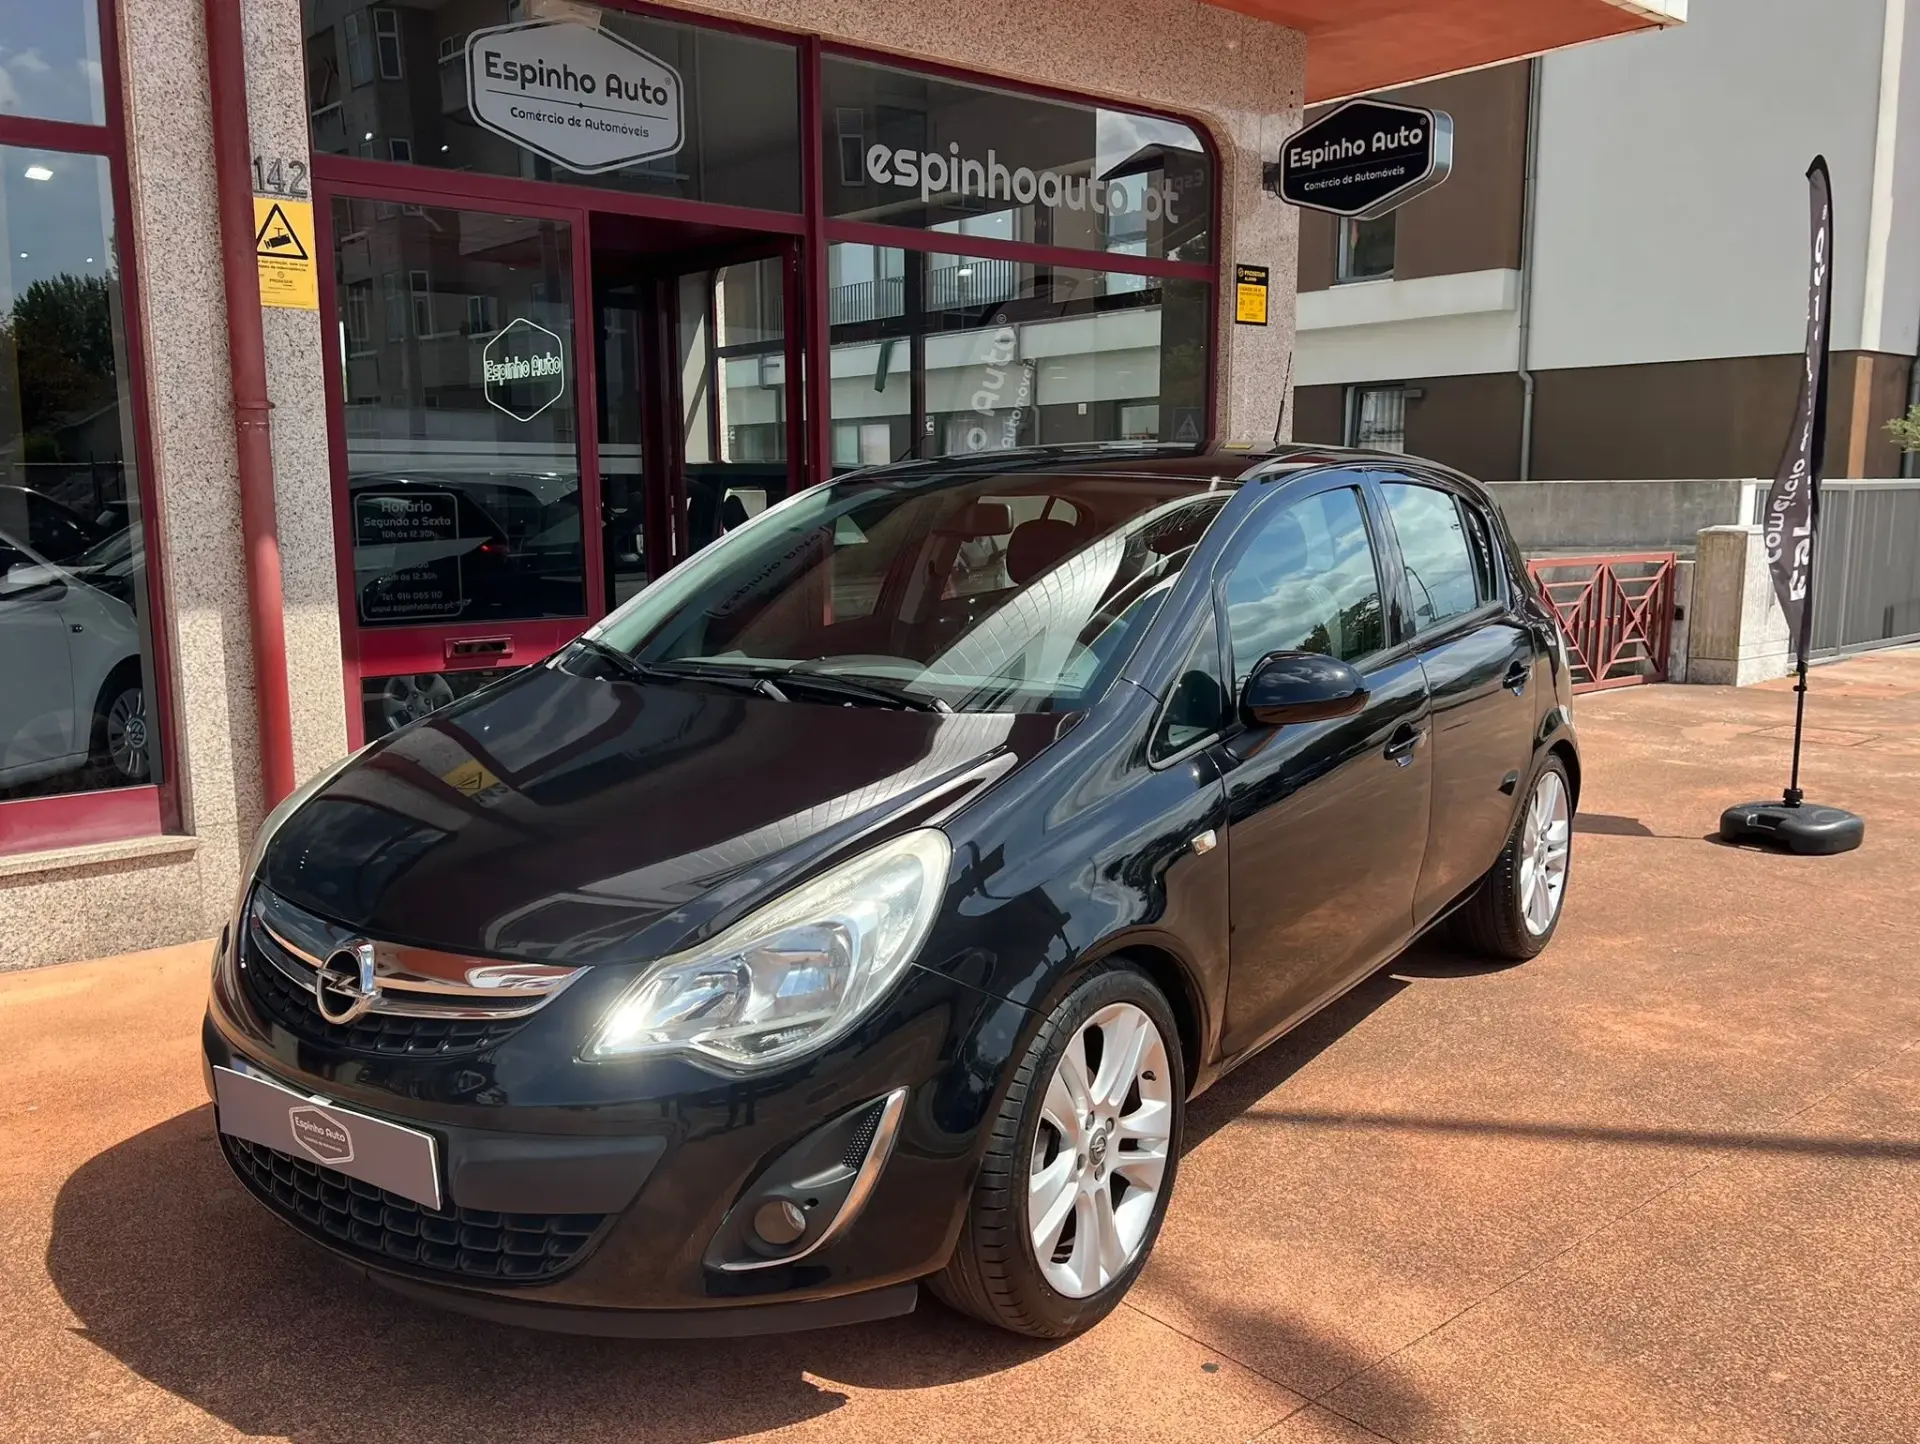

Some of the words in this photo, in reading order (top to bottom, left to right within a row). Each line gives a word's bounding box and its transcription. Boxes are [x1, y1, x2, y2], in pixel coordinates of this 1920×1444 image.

[484, 51, 596, 94] Espinho
[605, 73, 668, 106] Auto
[510, 106, 565, 126] Comércio
[567, 116, 582, 128] de
[585, 118, 650, 138] Automóveis
[1290, 137, 1365, 169] Espinho
[1372, 125, 1423, 152] Auto
[253, 155, 308, 197] 142
[1304, 175, 1341, 191] Comércio
[1342, 174, 1353, 184] de
[1354, 165, 1405, 182] Automóveis
[485, 355, 530, 386] Espinho
[531, 352, 561, 377] Auto
[971, 327, 1017, 417] Auto
[363, 517, 409, 528] Segunda
[421, 516, 451, 526] Sexta
[381, 499, 433, 513] Horário
[294, 1116, 325, 1136] Espinho
[325, 1128, 346, 1142] Auto
